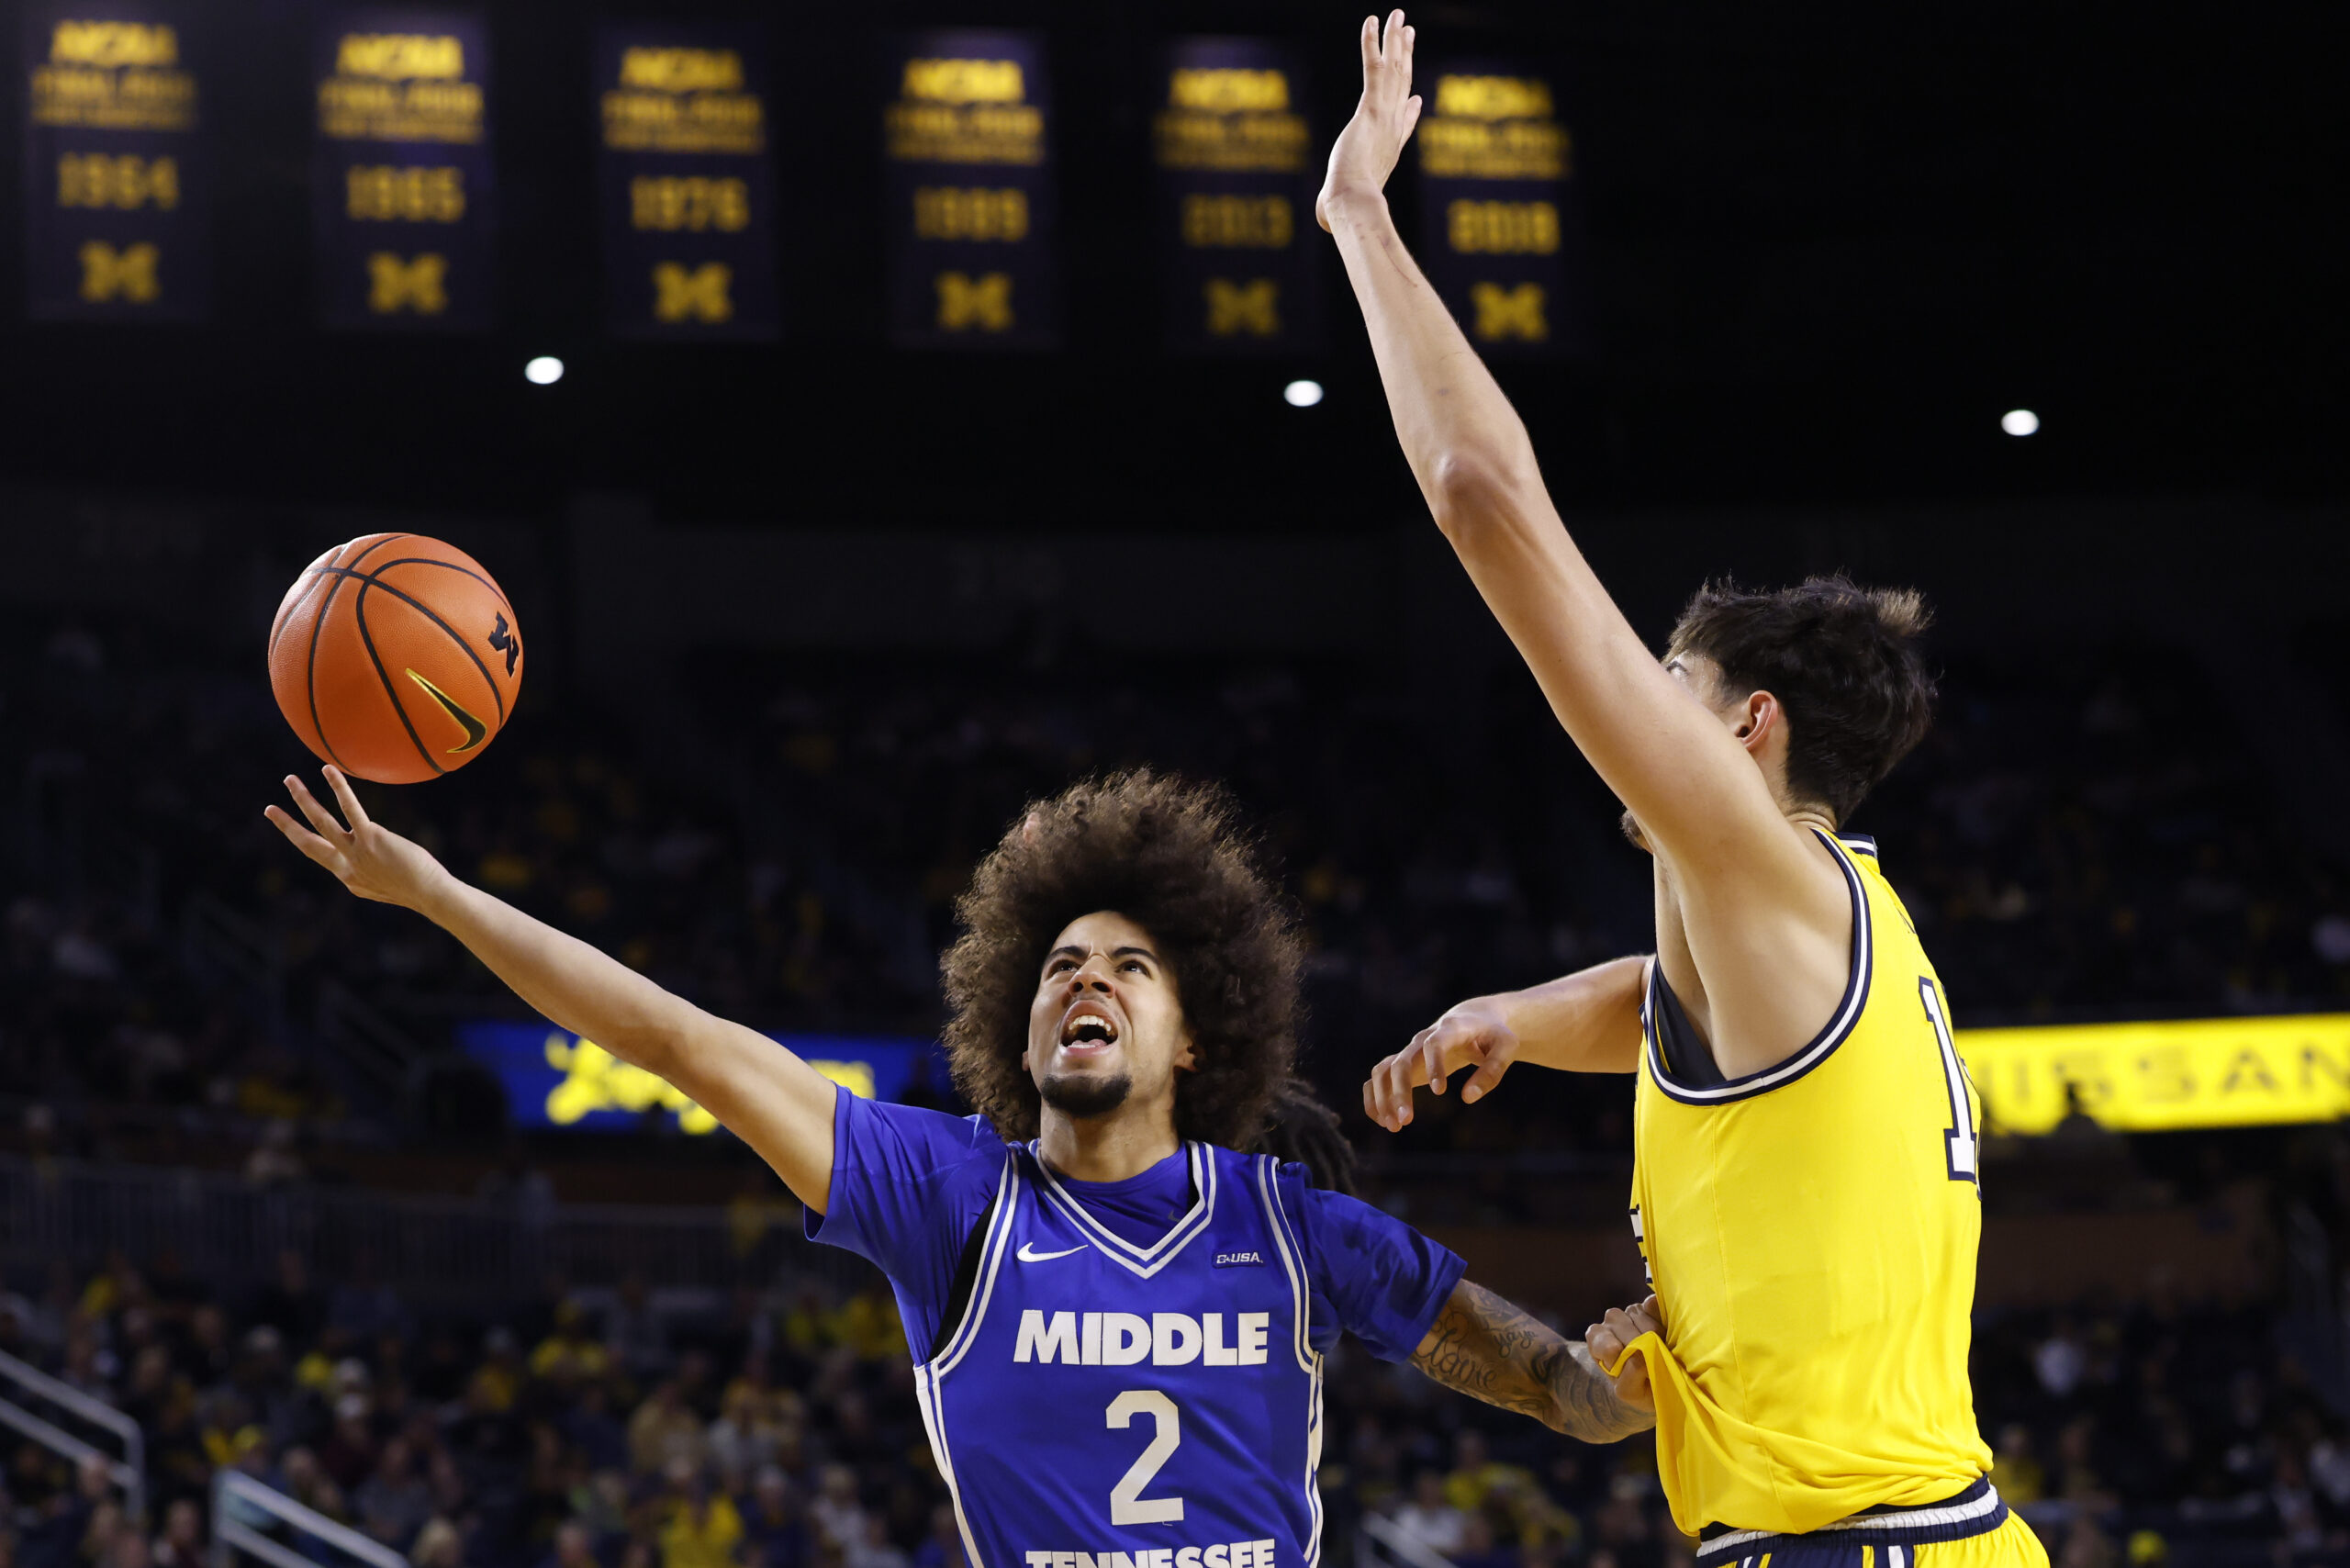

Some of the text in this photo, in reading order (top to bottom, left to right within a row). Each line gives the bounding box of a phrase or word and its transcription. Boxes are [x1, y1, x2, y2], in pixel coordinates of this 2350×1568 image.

[59, 153, 179, 210] 1964
[631, 176, 751, 231] 1976
[1919, 975, 1981, 1199] 1
[1975, 1043, 2350, 1105] ISSAN
[1013, 1309, 1270, 1366] MIDDLE
[1105, 1389, 1185, 1526] 2
